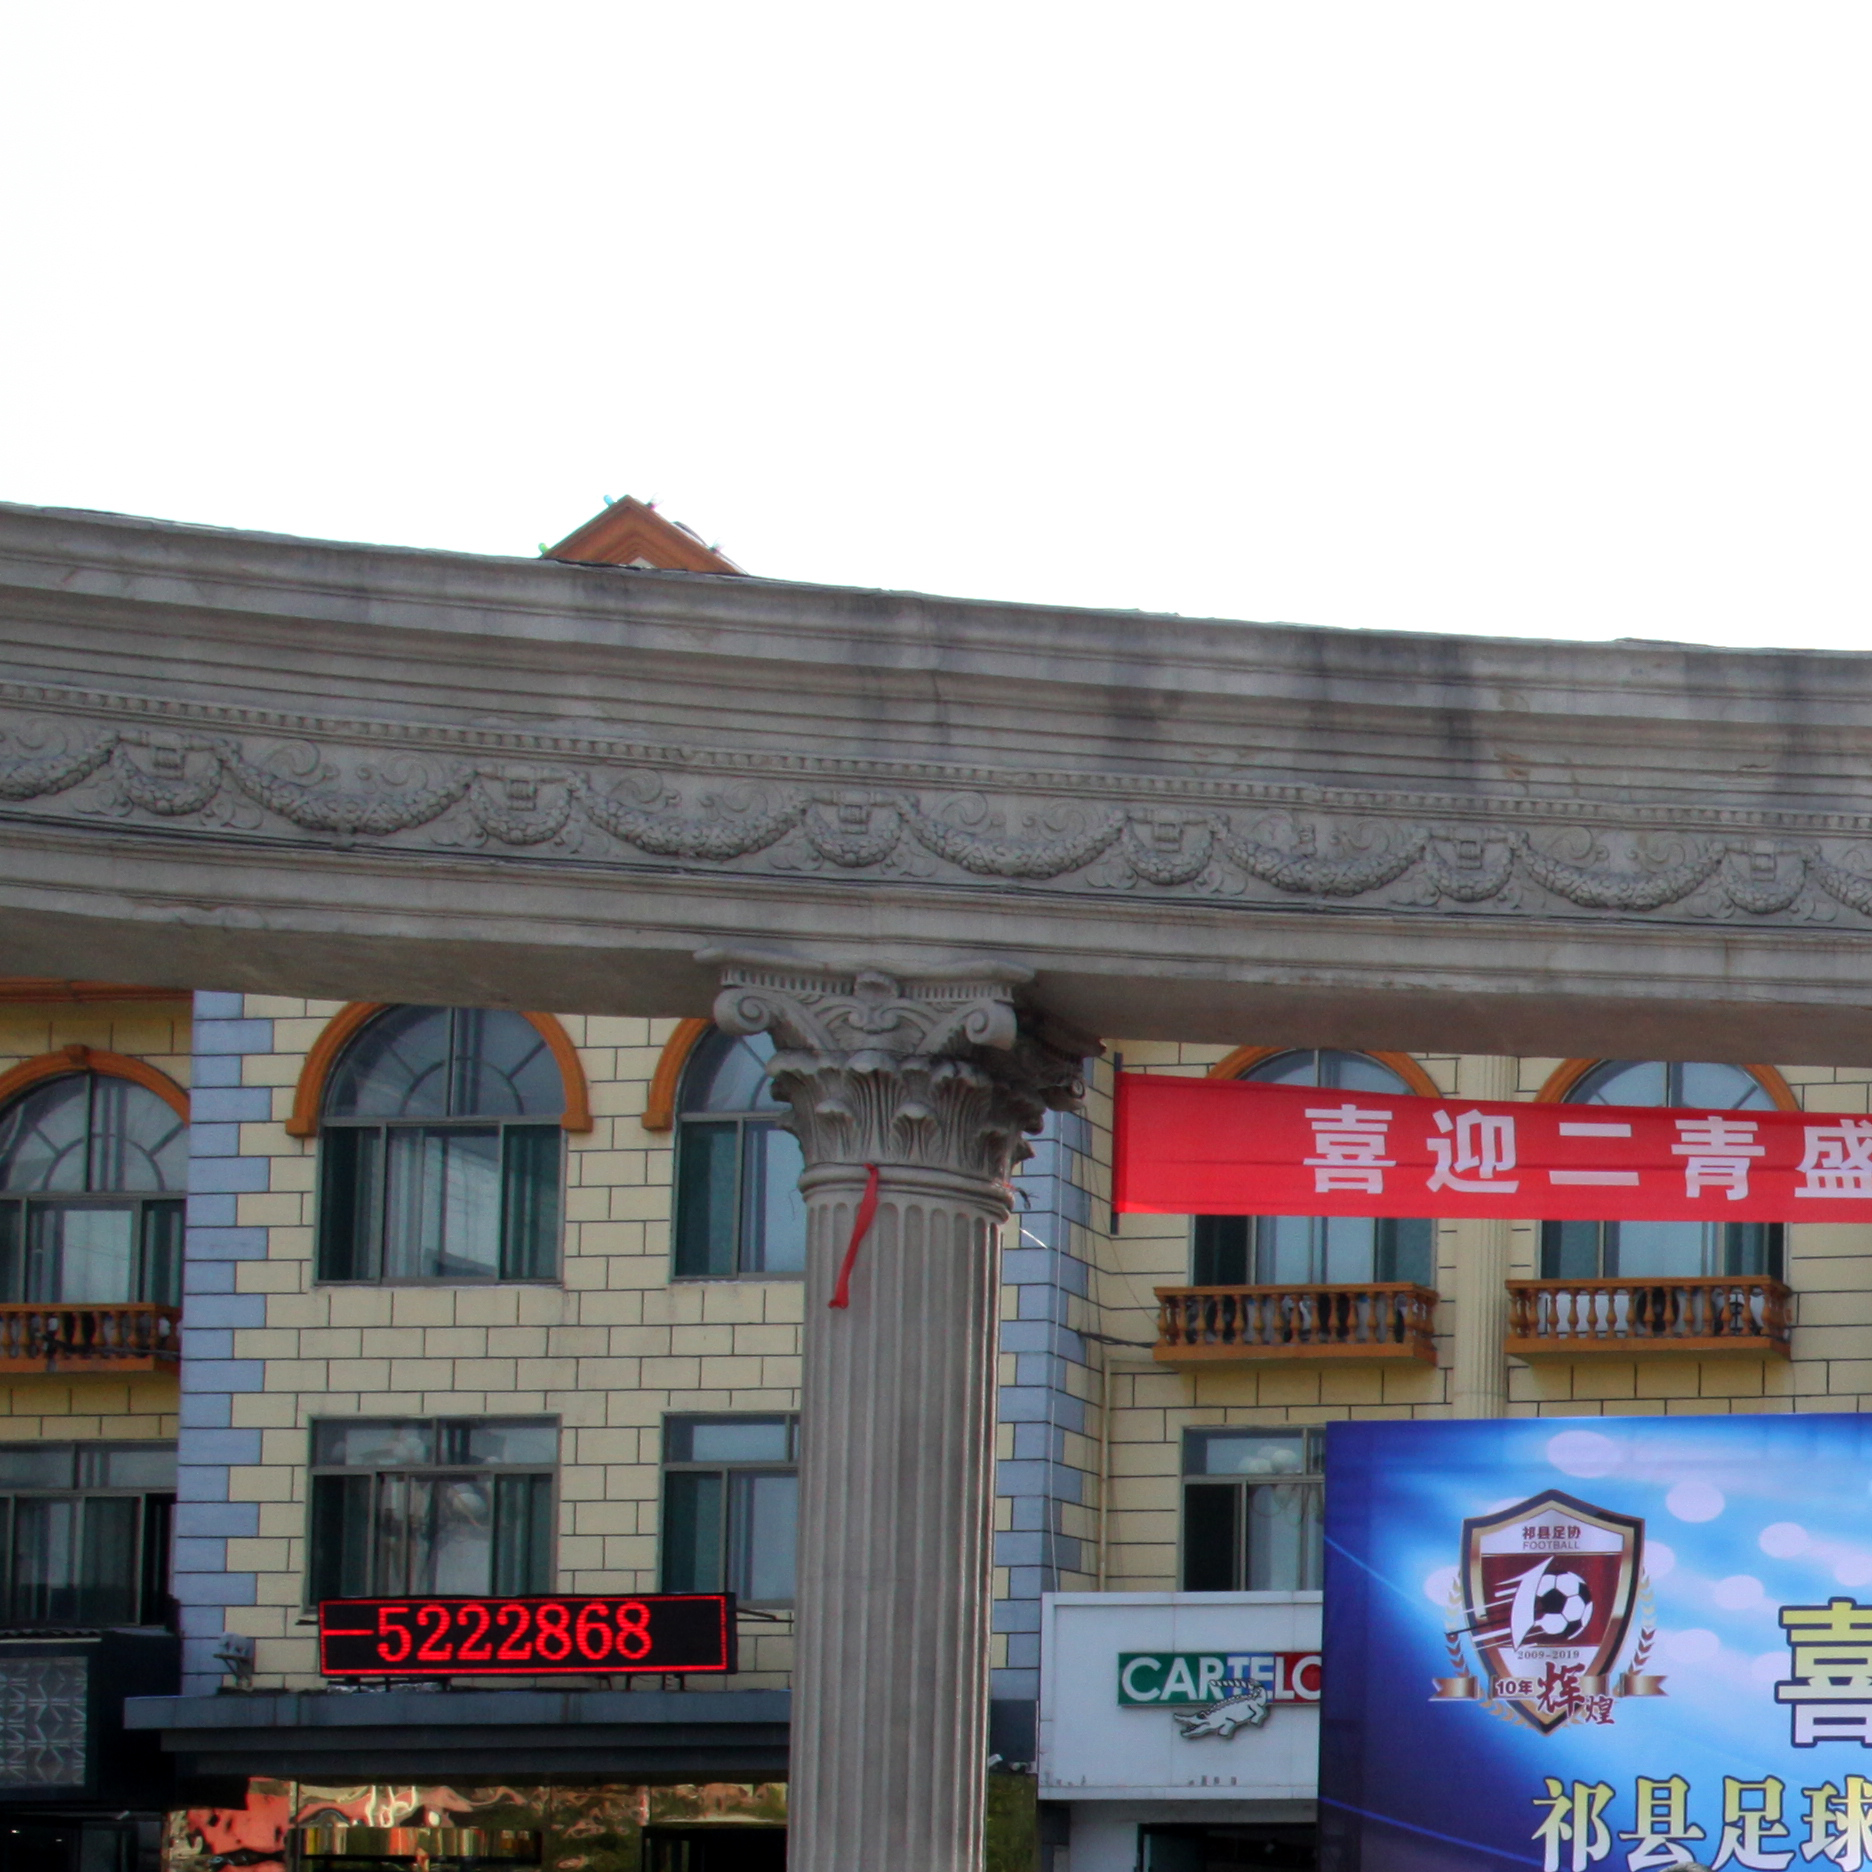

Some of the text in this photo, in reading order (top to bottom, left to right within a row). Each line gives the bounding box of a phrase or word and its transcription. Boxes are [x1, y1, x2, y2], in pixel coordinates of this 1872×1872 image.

[1521, 1525, 1582, 1541] 祁县足协
[1522, 1540, 1581, 1550] FOOTBALL
[1517, 1649, 1580, 1660] 2009-2019
[1121, 1655, 1322, 1702] CARTELO
[1494, 1660, 1616, 1727] 10年 辉煌
